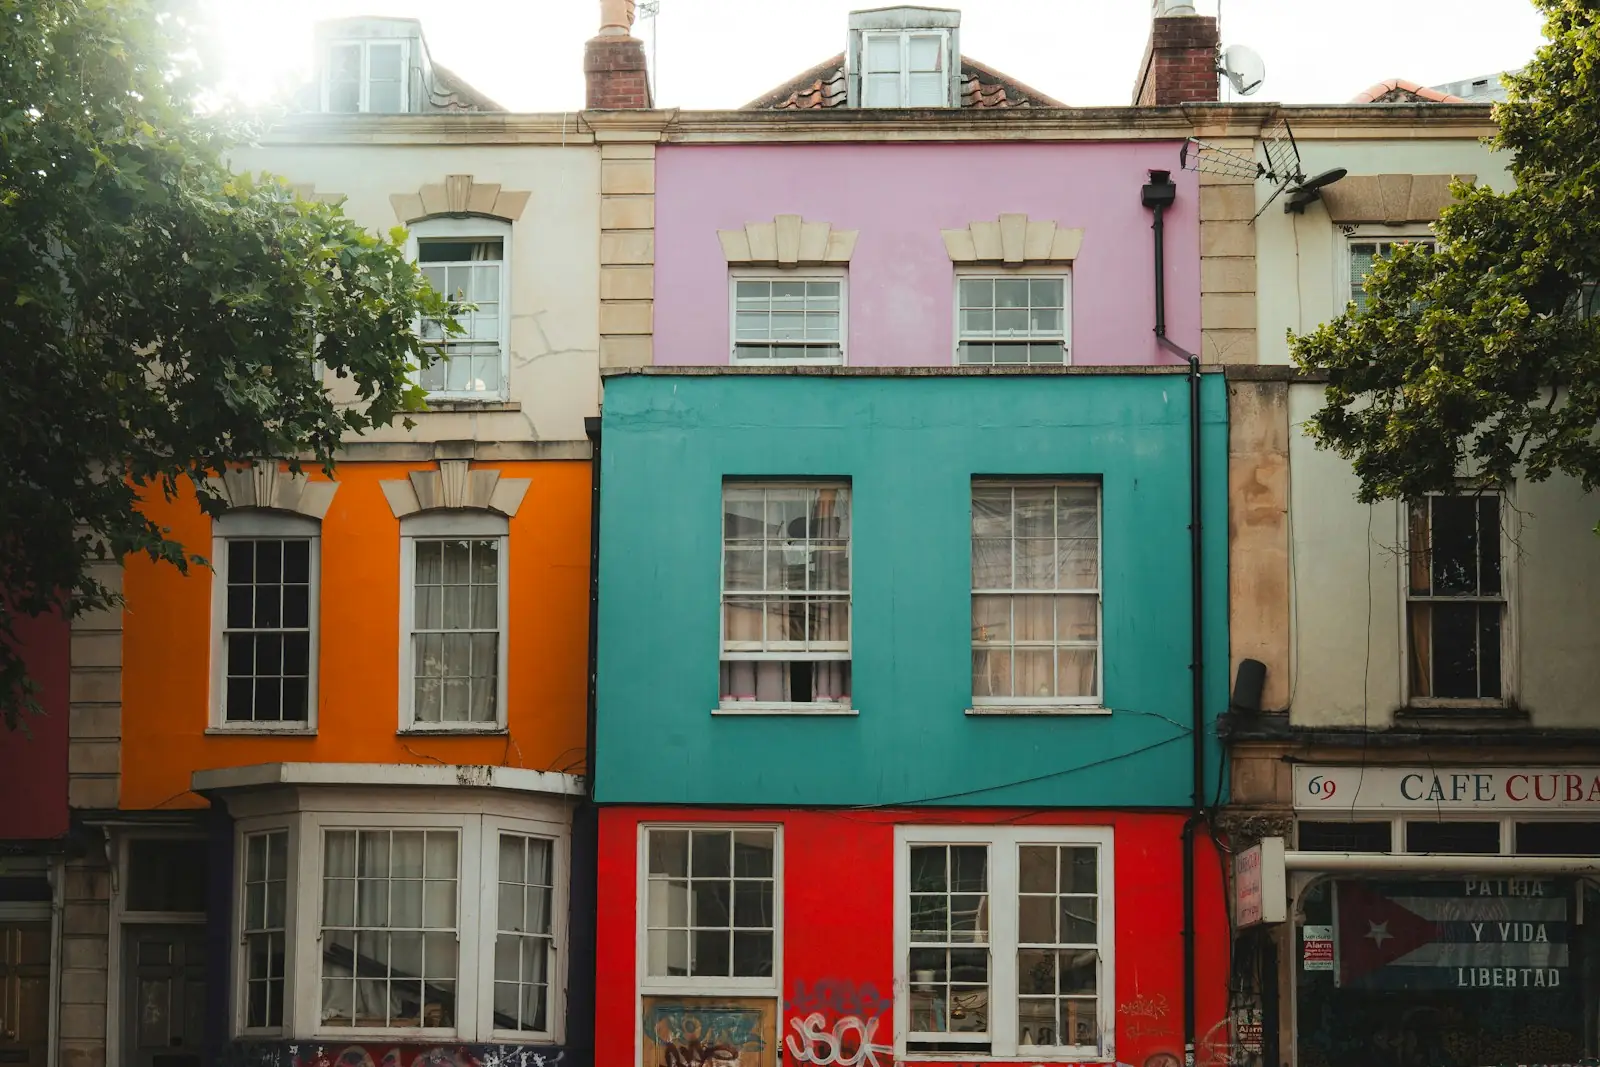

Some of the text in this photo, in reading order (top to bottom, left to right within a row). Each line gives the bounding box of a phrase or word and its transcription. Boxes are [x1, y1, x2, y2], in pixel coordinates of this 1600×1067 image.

[1308, 775, 1337, 801] 69
[1400, 774, 1600, 801] CAFE CUBA
[1464, 878, 1544, 896] PATRIA
[1471, 922, 1548, 942] Y VIDA
[1305, 941, 1332, 949] Alarm
[1457, 967, 1560, 988] LIBERTAD
